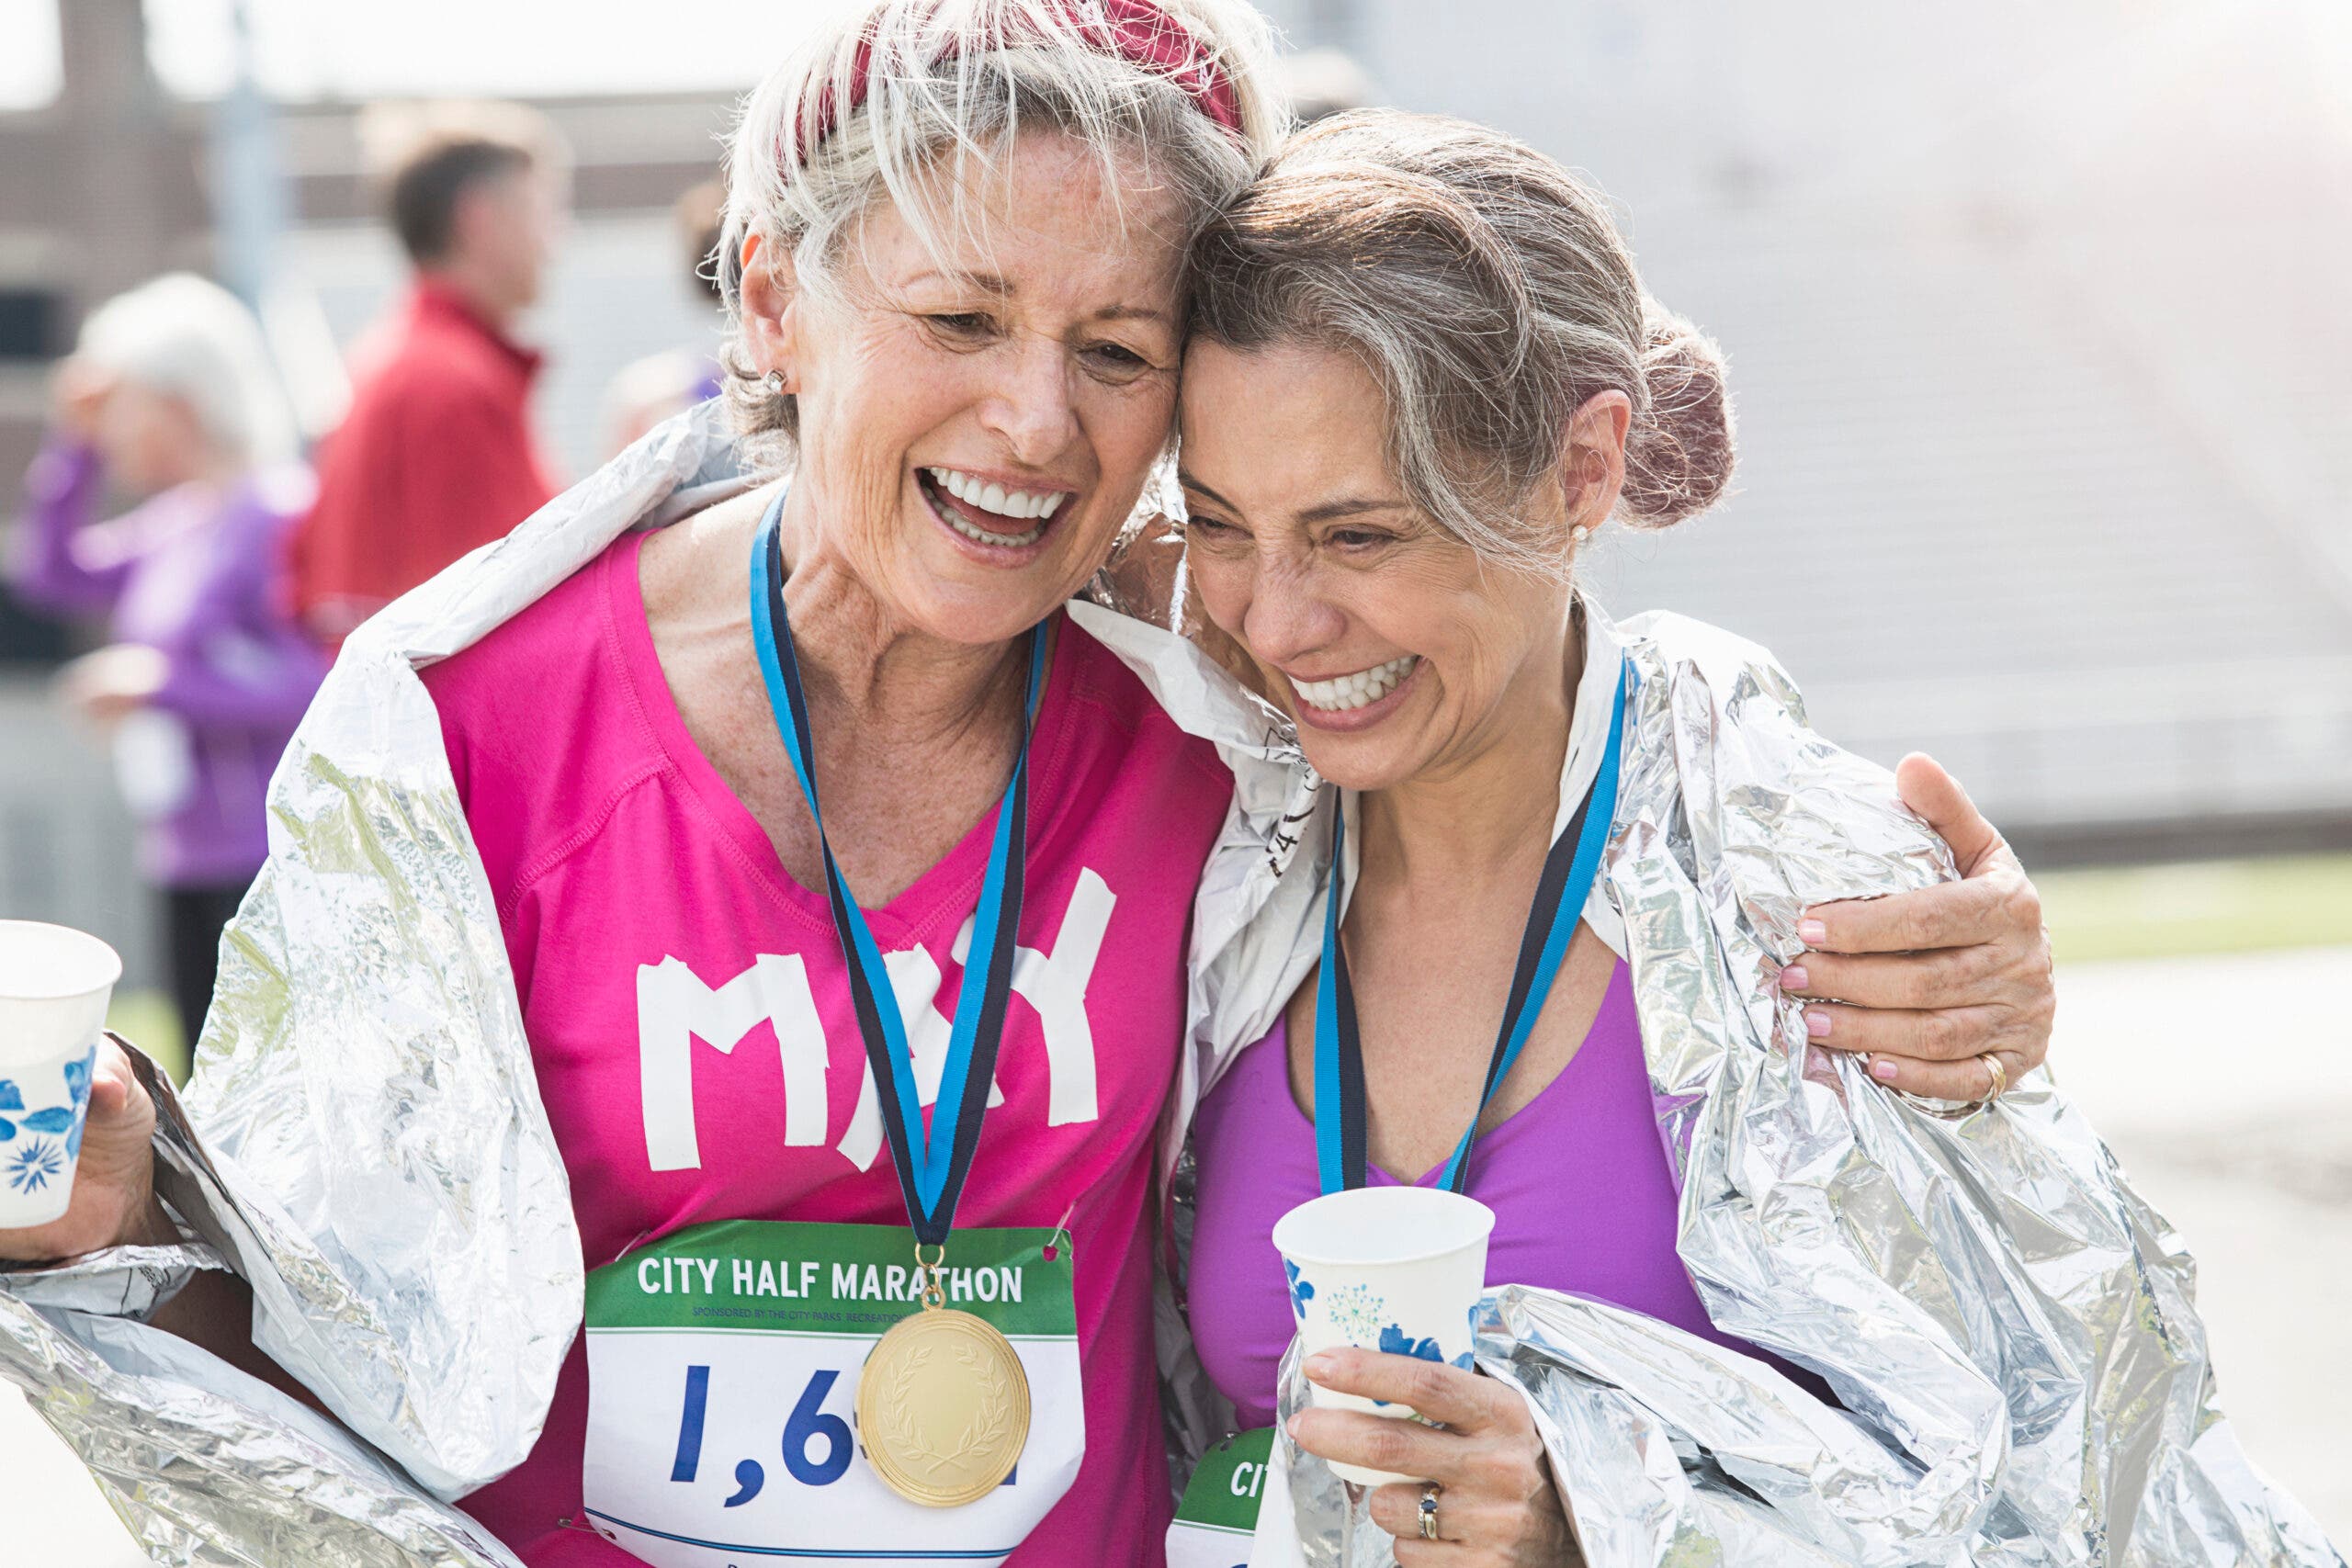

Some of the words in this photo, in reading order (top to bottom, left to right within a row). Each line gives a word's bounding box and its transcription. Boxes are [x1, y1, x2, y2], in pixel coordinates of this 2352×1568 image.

[636, 866, 1117, 1173] MAY
[638, 1258, 718, 1294] CITY
[732, 1259, 820, 1299] HALF
[831, 1263, 1023, 1303] MARATHON
[692, 1306, 752, 1318] SPONSORED
[754, 1309, 765, 1318] BY
[767, 1310, 786, 1320] THE
[787, 1311, 810, 1321] CITY
[812, 1312, 842, 1322] PARKS
